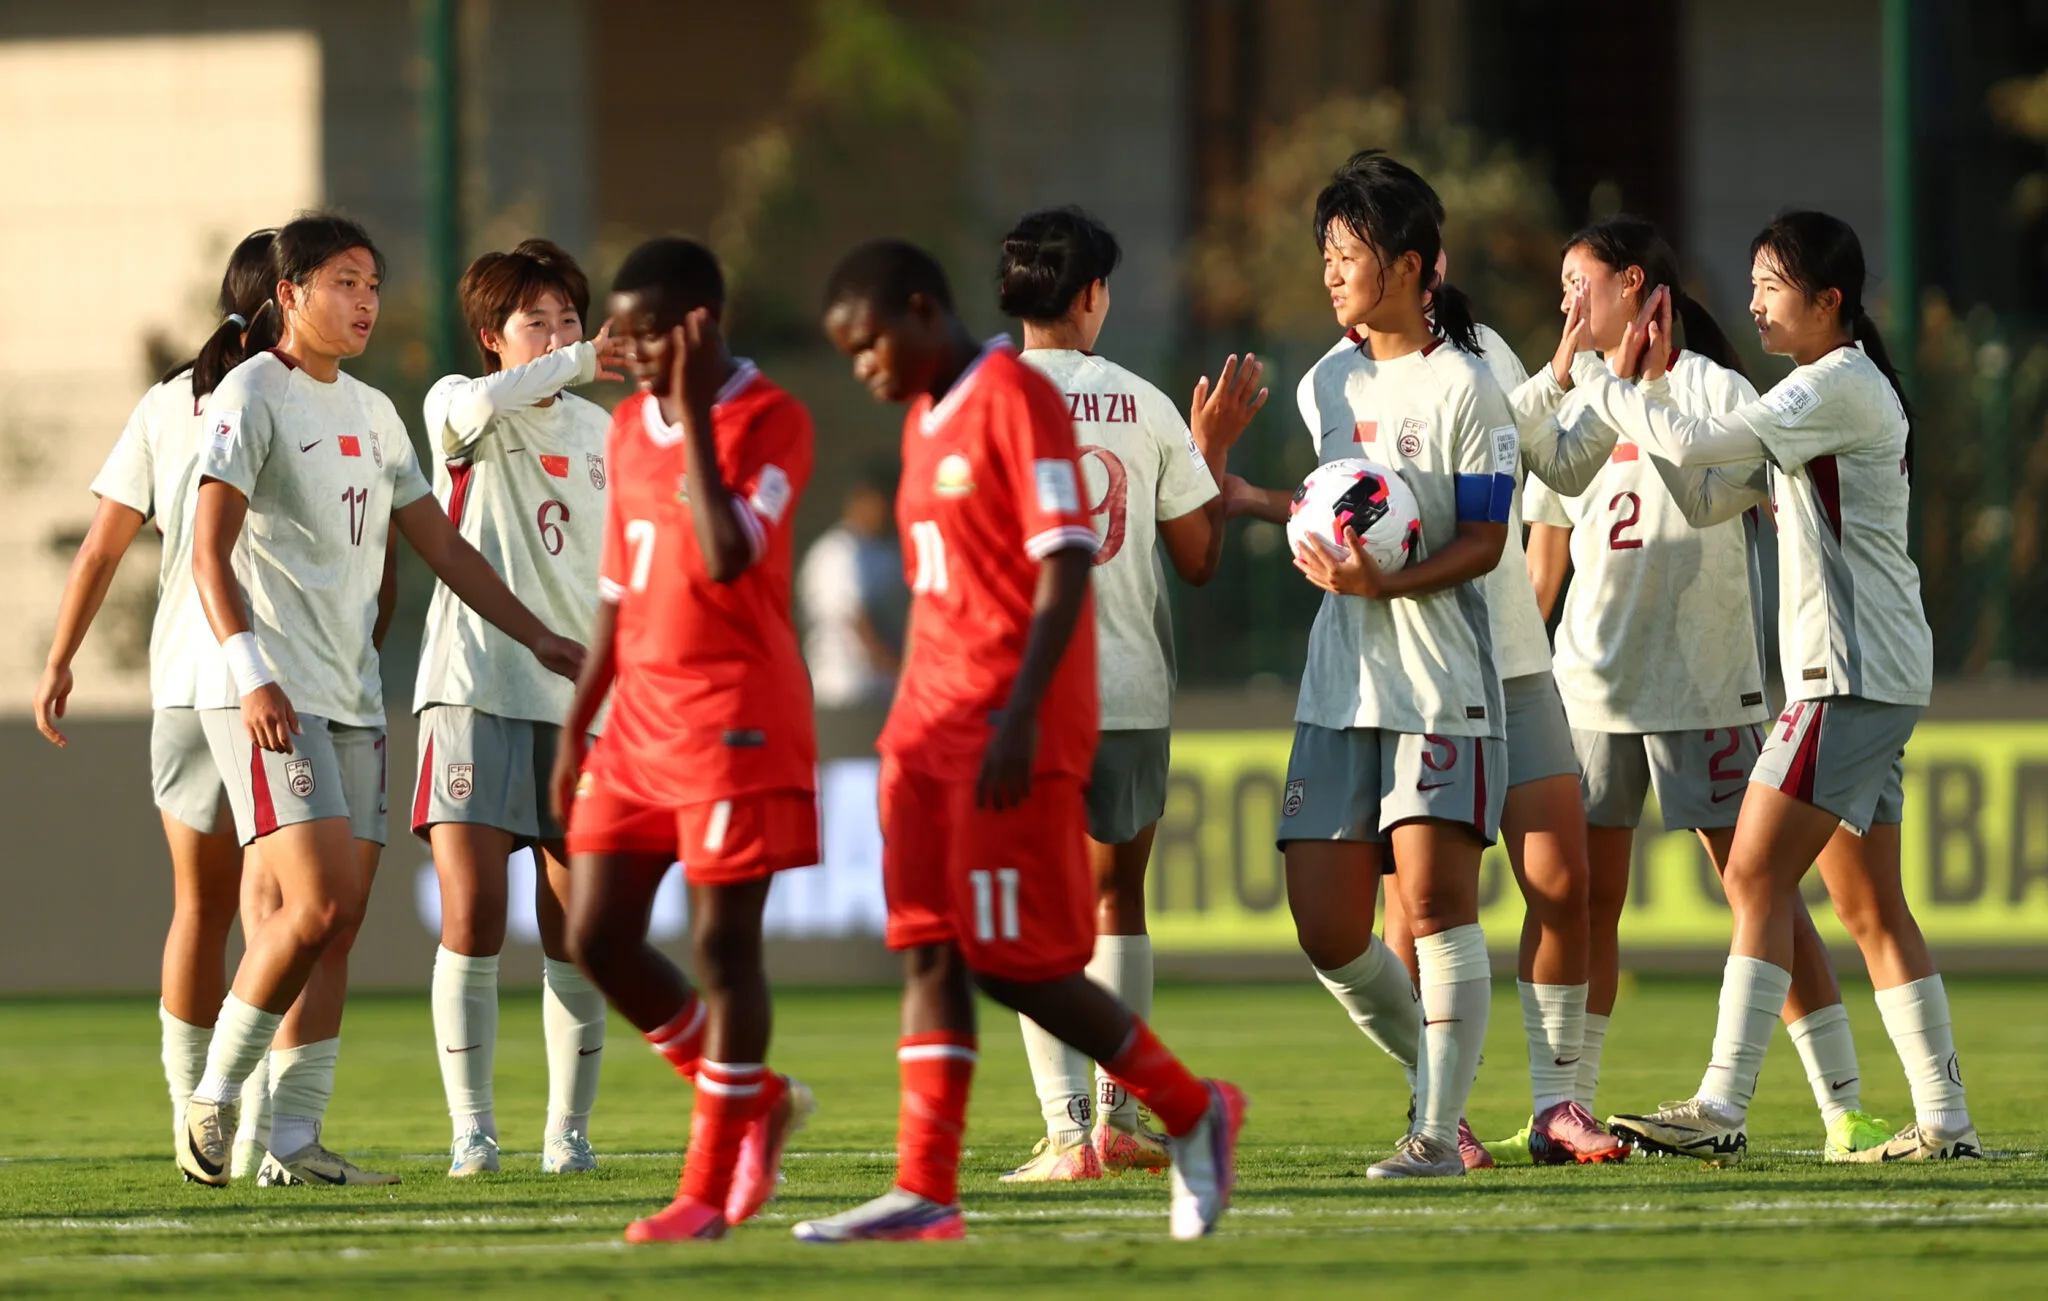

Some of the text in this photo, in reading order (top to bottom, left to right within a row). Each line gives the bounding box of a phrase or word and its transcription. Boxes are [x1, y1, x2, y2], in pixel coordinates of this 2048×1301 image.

[341, 486, 368, 546] 11
[537, 500, 570, 556] 6
[1608, 491, 1643, 550] 2
[625, 519, 656, 594] 7
[910, 519, 948, 595] 11
[1779, 702, 1805, 742] 4
[1704, 727, 1744, 781] 2
[969, 867, 1020, 943] 11
